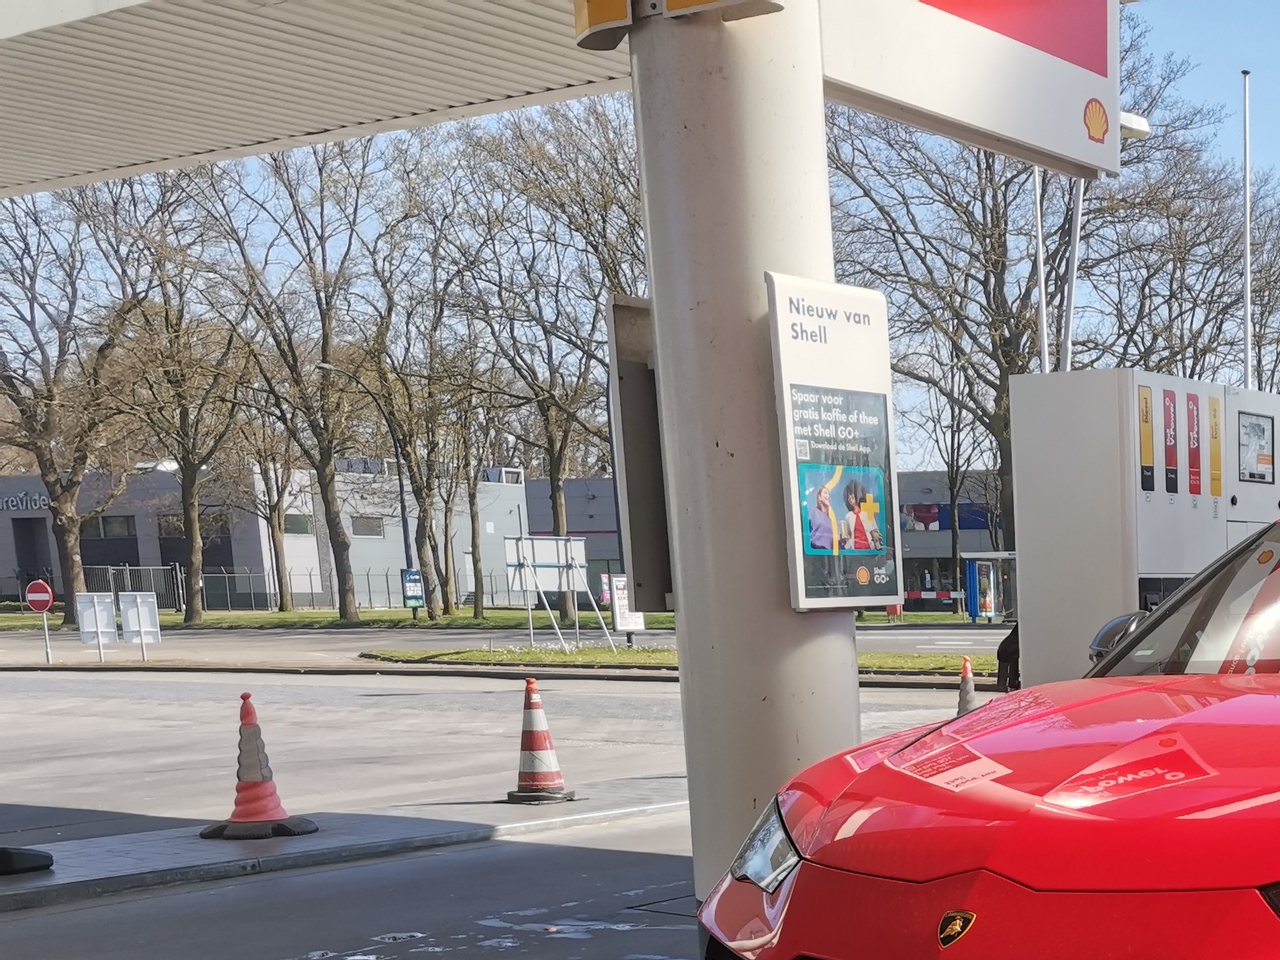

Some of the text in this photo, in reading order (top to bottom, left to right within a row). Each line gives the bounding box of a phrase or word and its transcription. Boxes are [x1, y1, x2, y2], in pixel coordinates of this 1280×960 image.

[788, 296, 871, 326] Nieuw van
[790, 322, 828, 344] Shell
[791, 388, 844, 405] Spaar voor
[793, 406, 879, 425] gratis koffie of thee
[794, 423, 860, 439] met Shell GO+
[810, 440, 837, 450] Download
[0, 491, 51, 510] revide
[874, 574, 890, 584] GO+
